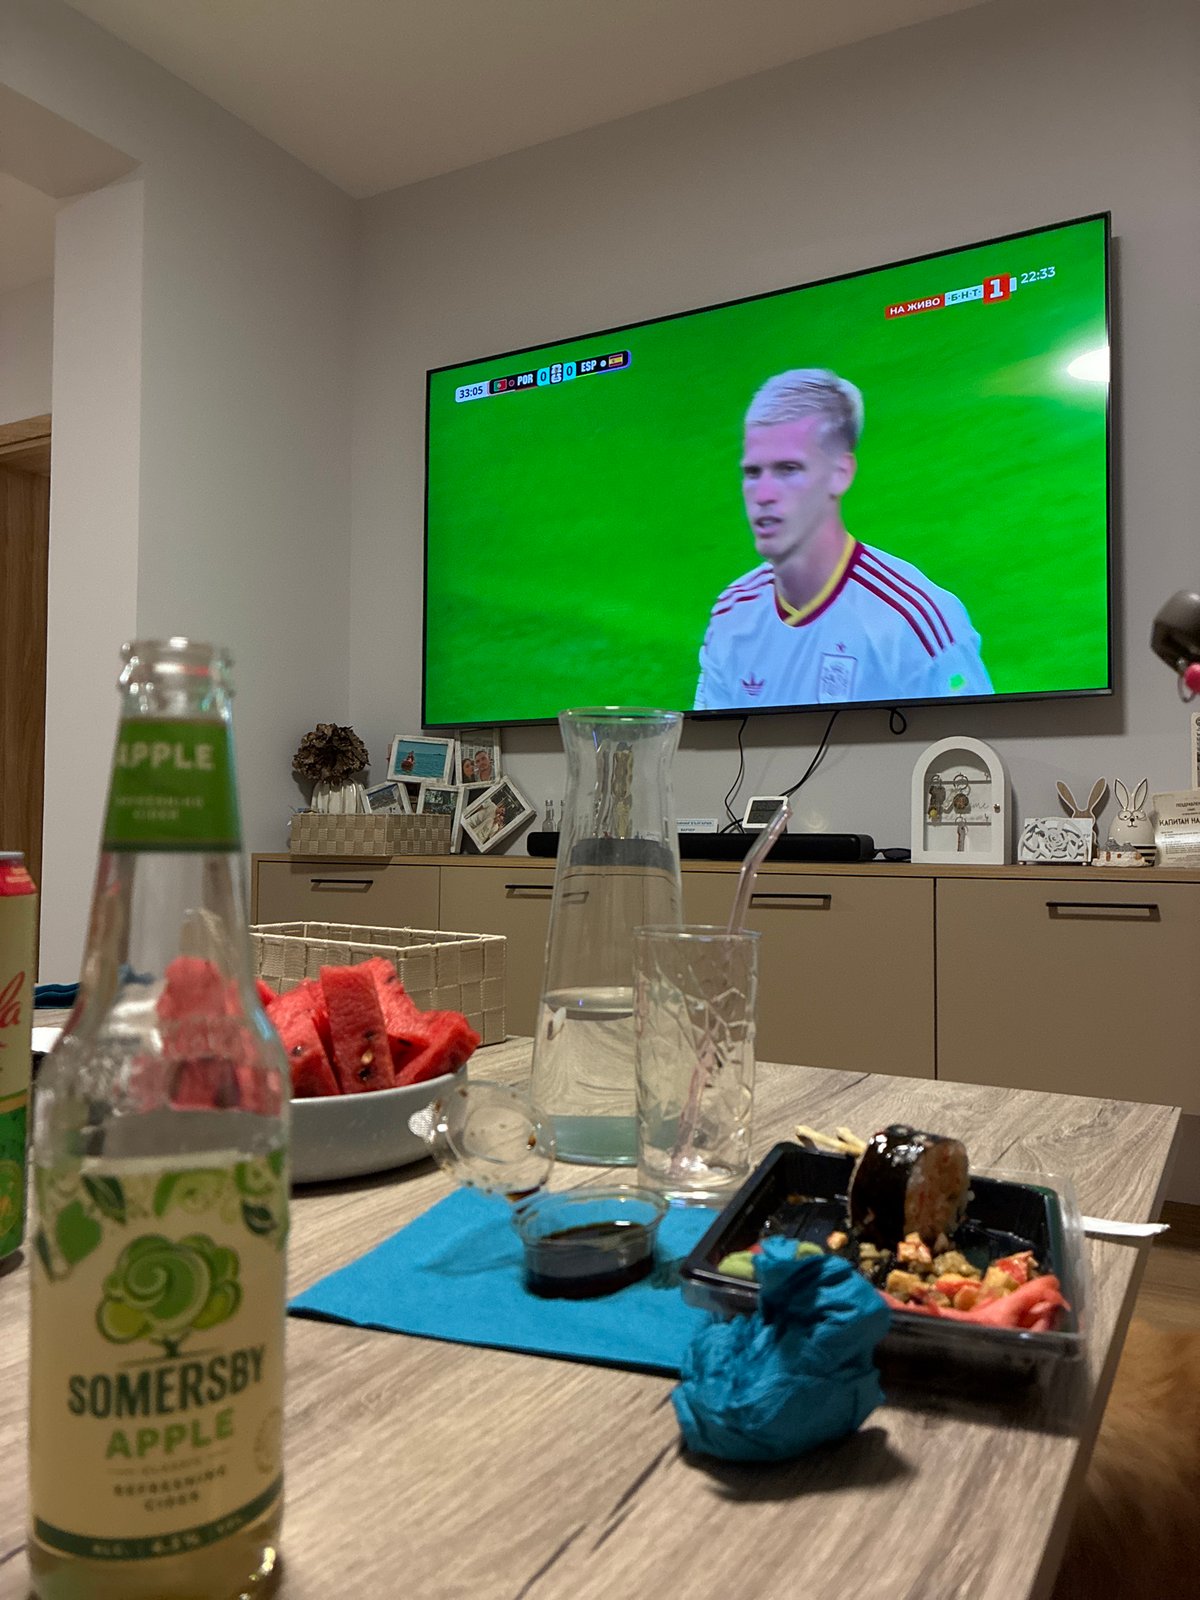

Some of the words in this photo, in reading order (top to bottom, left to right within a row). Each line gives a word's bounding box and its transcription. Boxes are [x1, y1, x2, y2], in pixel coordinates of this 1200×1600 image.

[889, 306, 905, 316] НА
[906, 297, 941, 312] ЖИВО
[989, 278, 1004, 299] 1
[1020, 266, 1056, 284] 22:33
[459, 386, 483, 399] 33:05
[517, 375, 533, 386] POR
[540, 371, 547, 382] 0
[566, 365, 573, 376] 0
[581, 360, 597, 372] ESP
[1159, 817, 1189, 826] КАПИТАН
[68, 1345, 265, 1419] SOMERSBY
[105, 1406, 235, 1459] APPLE
